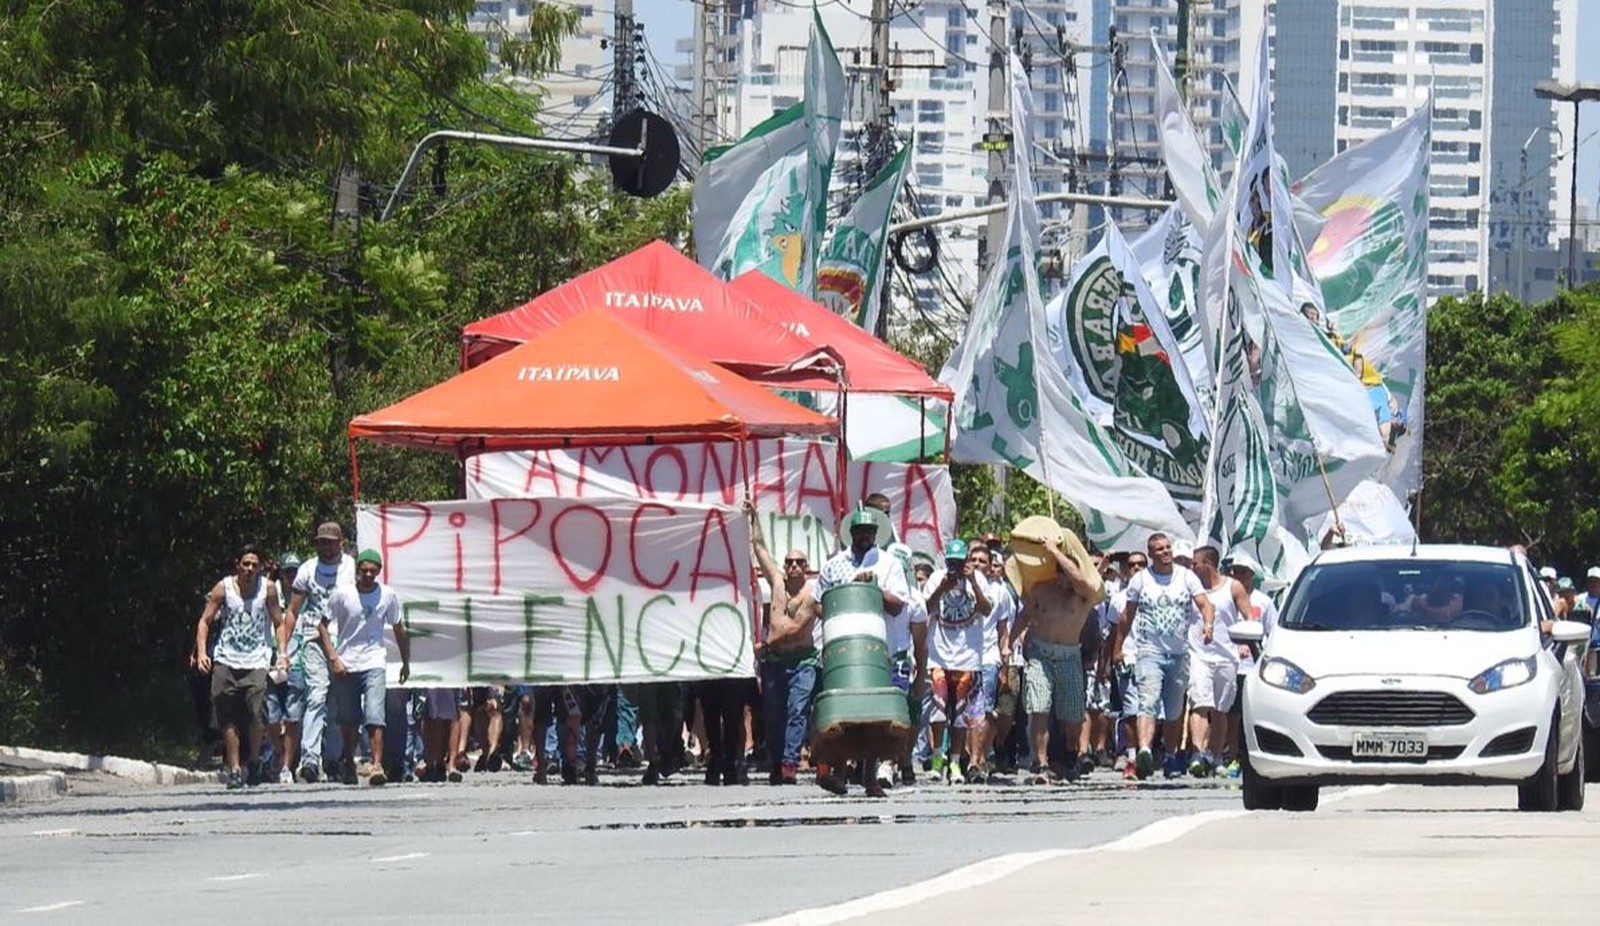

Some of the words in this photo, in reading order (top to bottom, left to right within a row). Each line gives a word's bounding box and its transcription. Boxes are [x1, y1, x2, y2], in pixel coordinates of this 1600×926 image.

[605, 291, 704, 312] ITAIPAVA
[518, 365, 620, 381] ITAIPAVA
[474, 437, 848, 516] AMONHA
[402, 594, 746, 682] ELENCO
